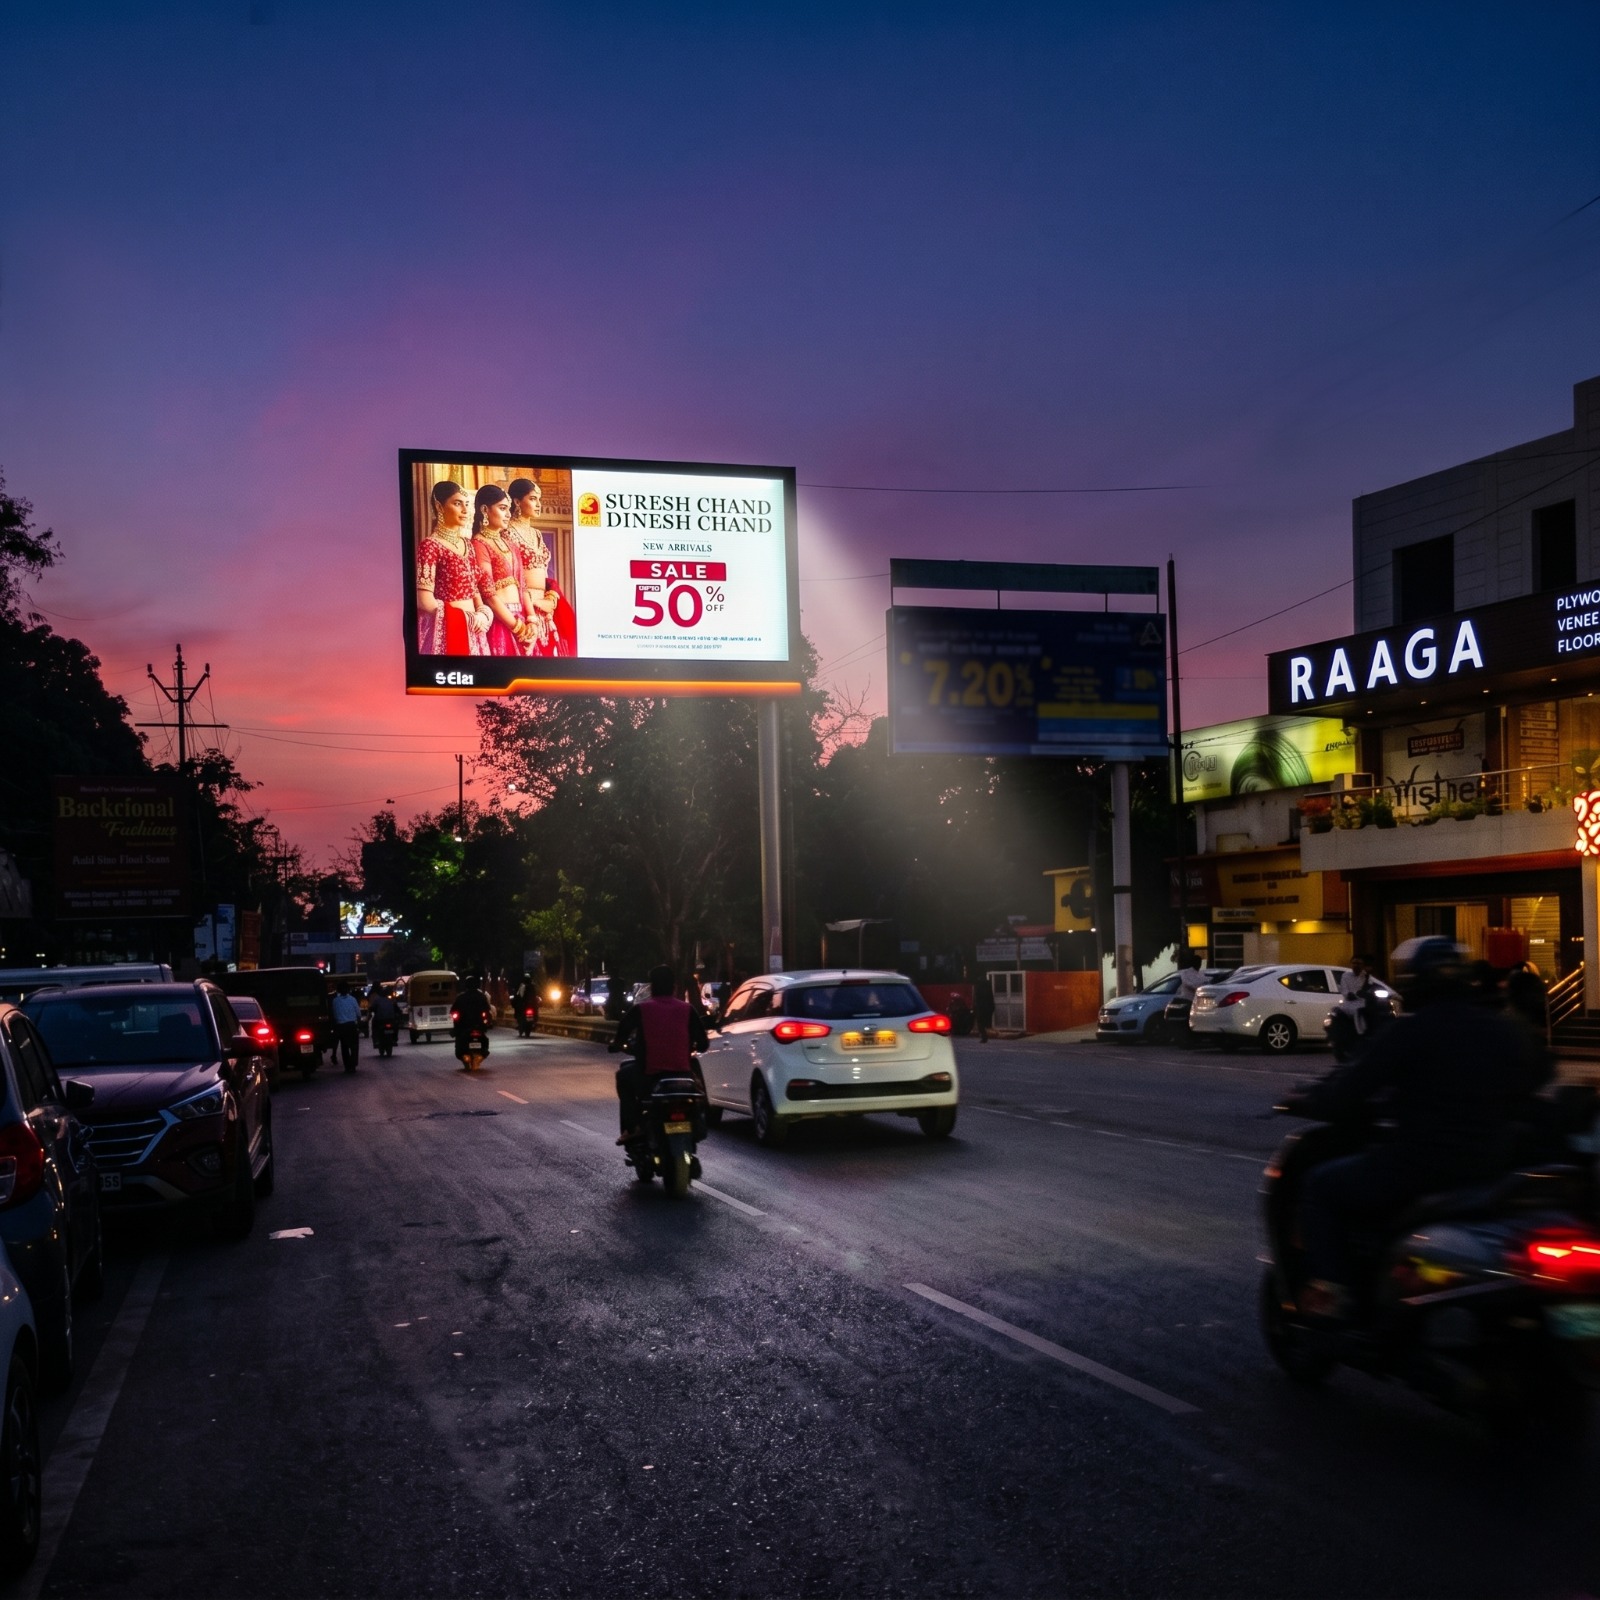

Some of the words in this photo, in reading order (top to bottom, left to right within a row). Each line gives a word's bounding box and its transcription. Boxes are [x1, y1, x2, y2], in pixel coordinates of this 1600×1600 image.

[605, 493, 691, 512] SURESH
[697, 497, 771, 516] CHAND
[606, 512, 691, 530] DINESH
[697, 515, 772, 534] CHAND
[642, 541, 664, 551] NEW
[668, 543, 713, 552] ARRIVALS
[650, 562, 708, 579] SALE
[705, 604, 725, 612] OFF
[1557, 611, 1600, 632] VENEE
[1289, 618, 1485, 705] RAAGA
